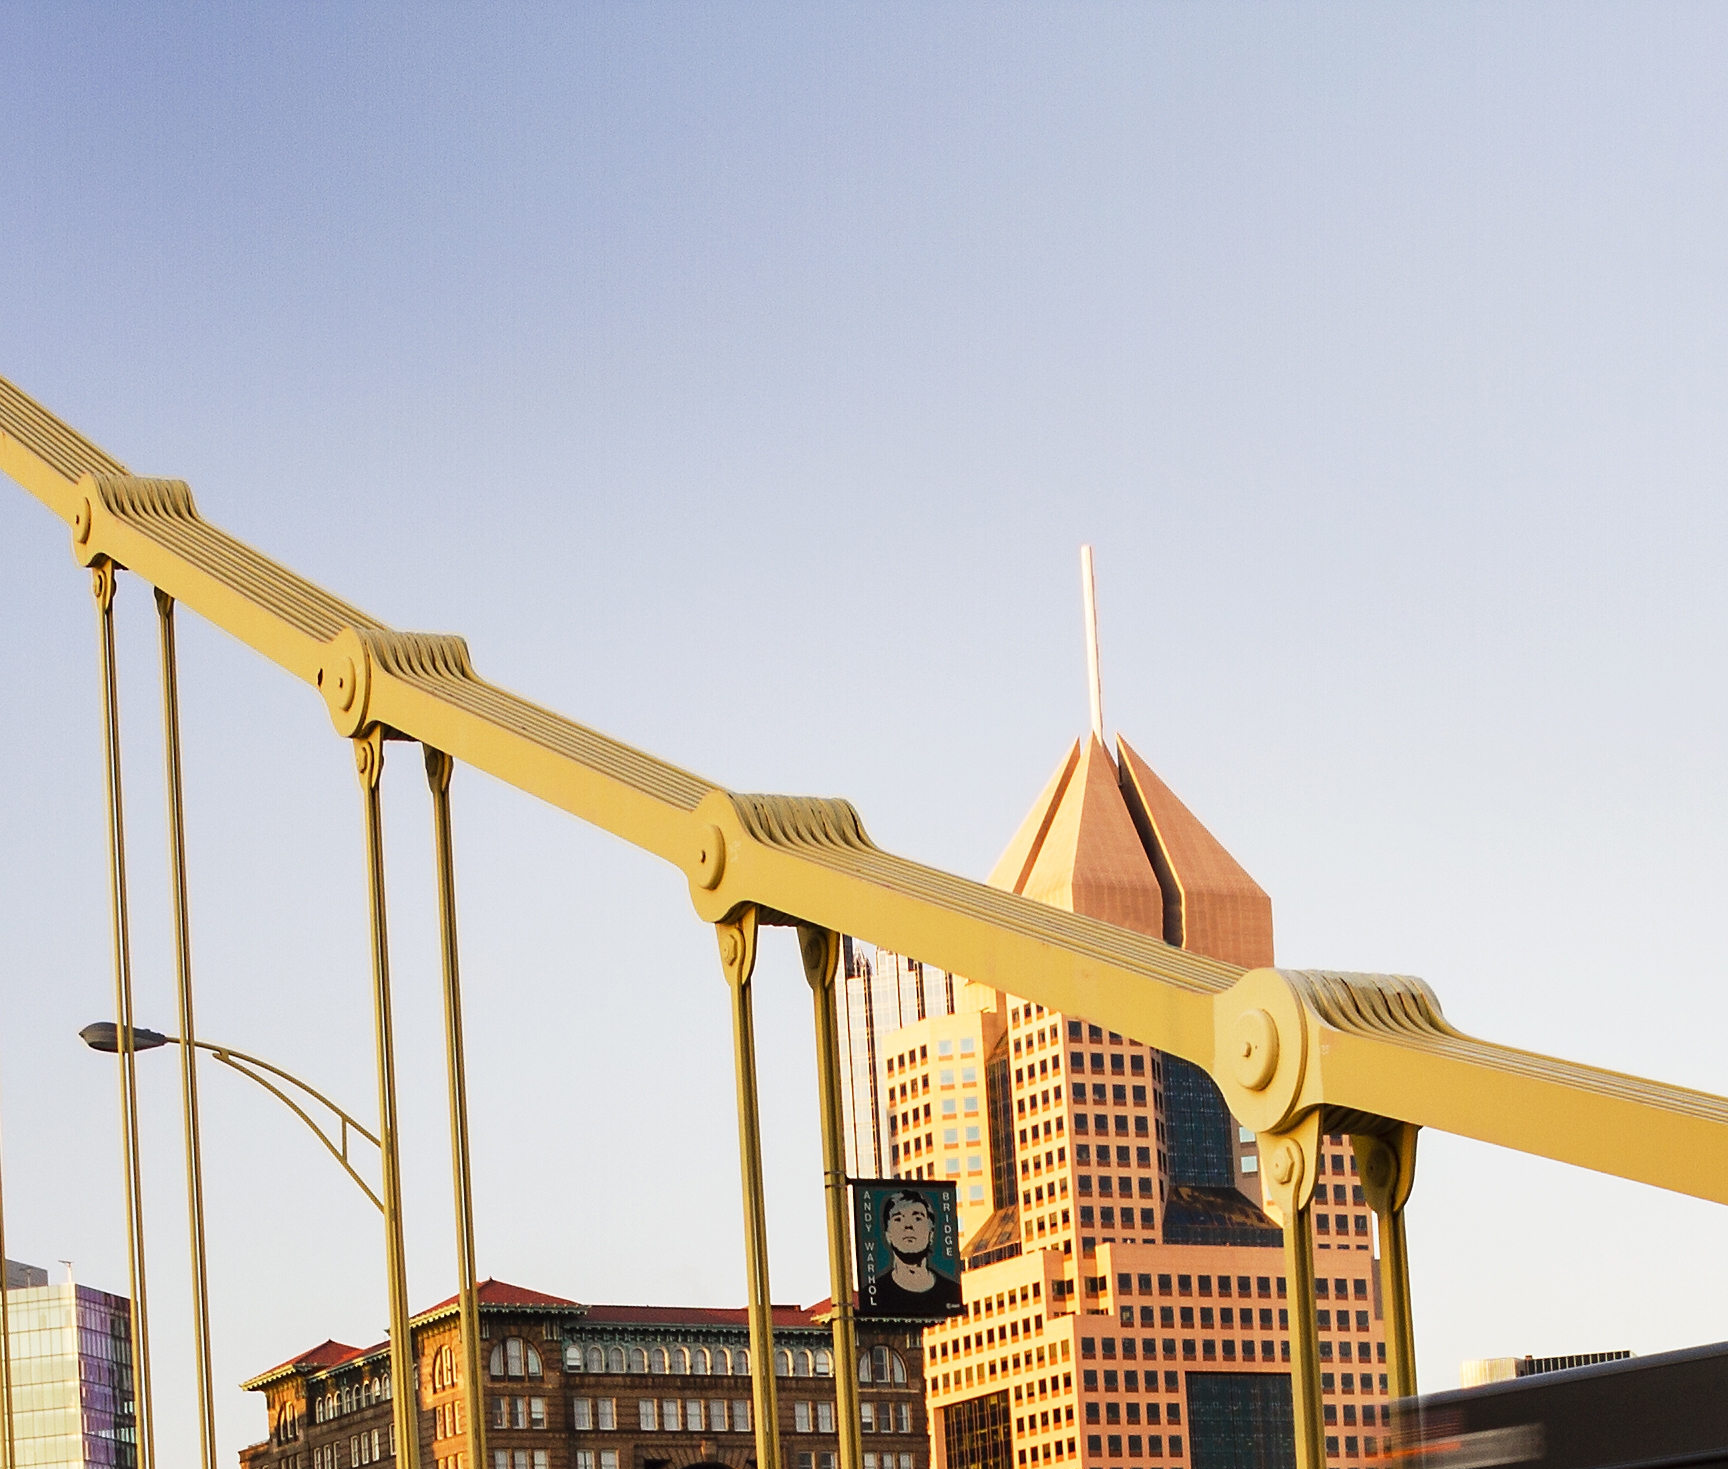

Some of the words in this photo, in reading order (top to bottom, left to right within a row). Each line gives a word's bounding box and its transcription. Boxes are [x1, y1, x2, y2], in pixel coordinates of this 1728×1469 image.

[863, 1190, 872, 1233] ANDY
[942, 1192, 953, 1257] BRIDGE
[865, 1242, 877, 1306] WARHOL
